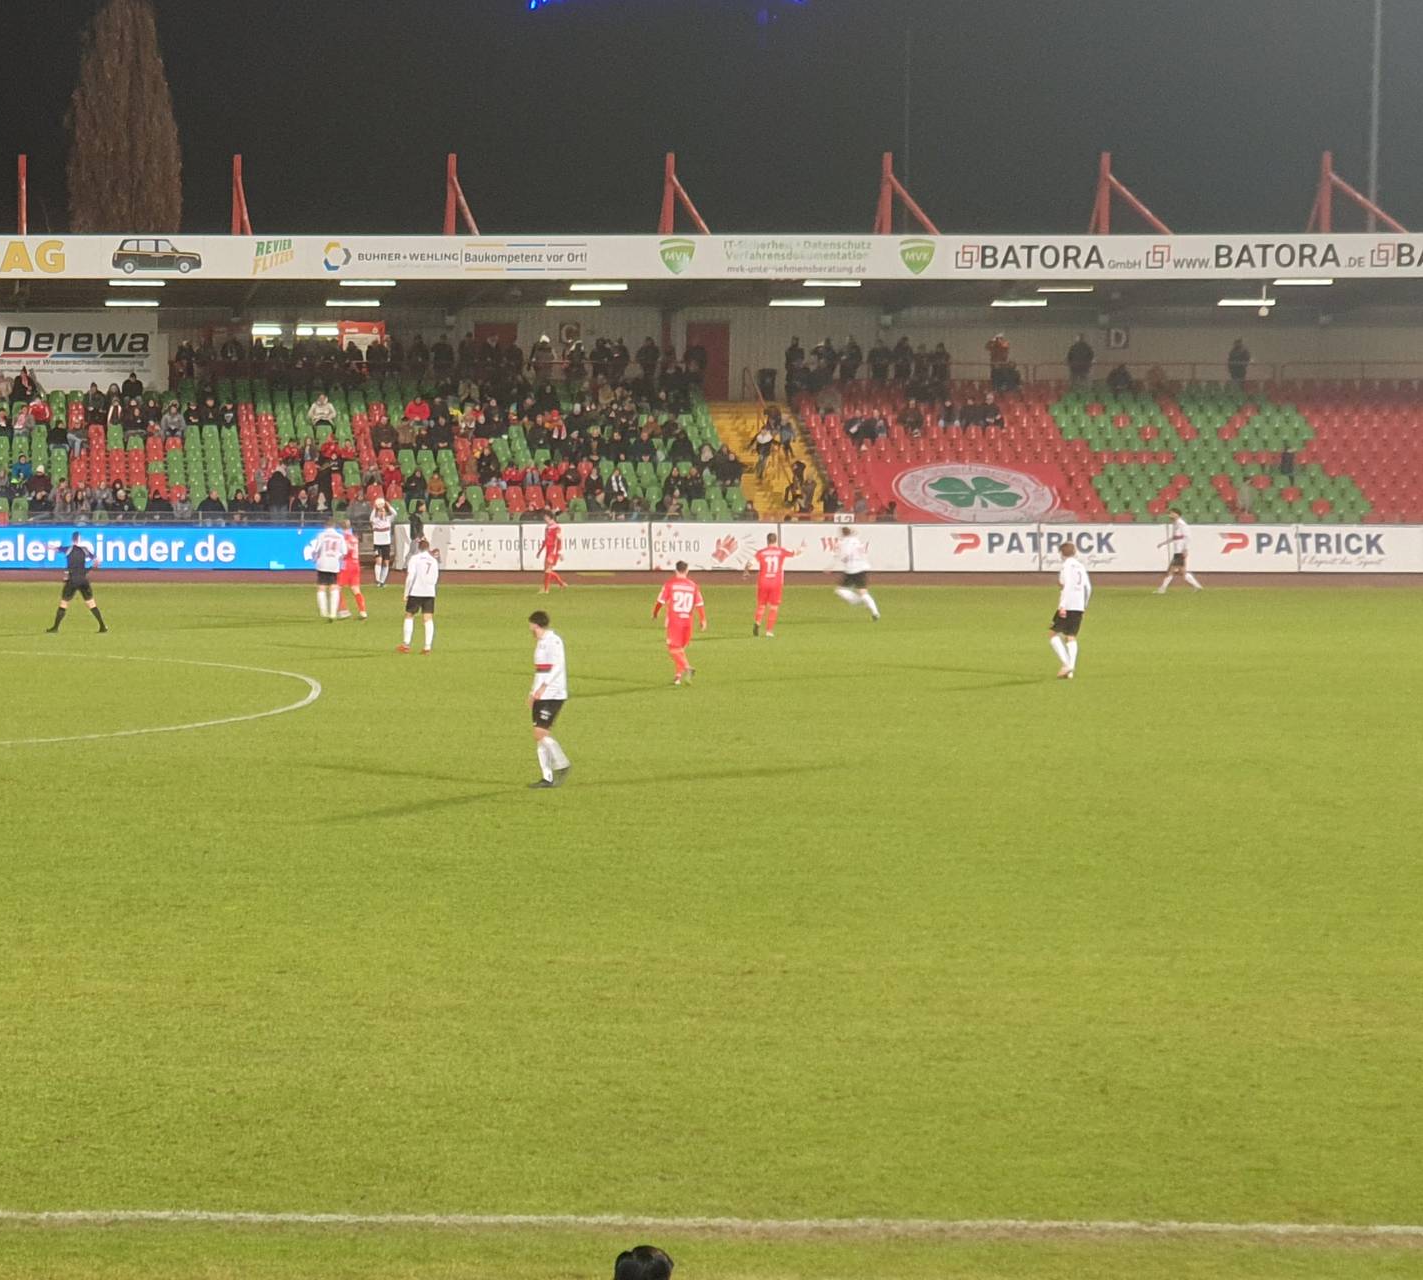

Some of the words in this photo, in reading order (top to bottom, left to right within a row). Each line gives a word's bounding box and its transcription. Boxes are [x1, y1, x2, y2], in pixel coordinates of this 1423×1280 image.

[255, 239, 292, 256] REVIER
[803, 240, 872, 250] Datenschutz
[409, 252, 459, 261] WEHLING
[464, 252, 543, 265] Baukompetenz
[547, 254, 564, 262] vor
[567, 252, 588, 263] Ort!
[904, 251, 928, 261] MVK
[980, 245, 1104, 269] BATORA
[1108, 259, 1141, 270] GmbH
[3, 326, 150, 352] Derewa
[1111, 329, 1127, 347] D
[462, 539, 492, 551] COME
[564, 538, 577, 550] IM
[581, 537, 647, 550] WESTFIELD
[654, 540, 700, 553] CENTRO
[1255, 532, 1385, 555] PATRICK
[765, 556, 779, 573] 11
[673, 591, 694, 613] 20
